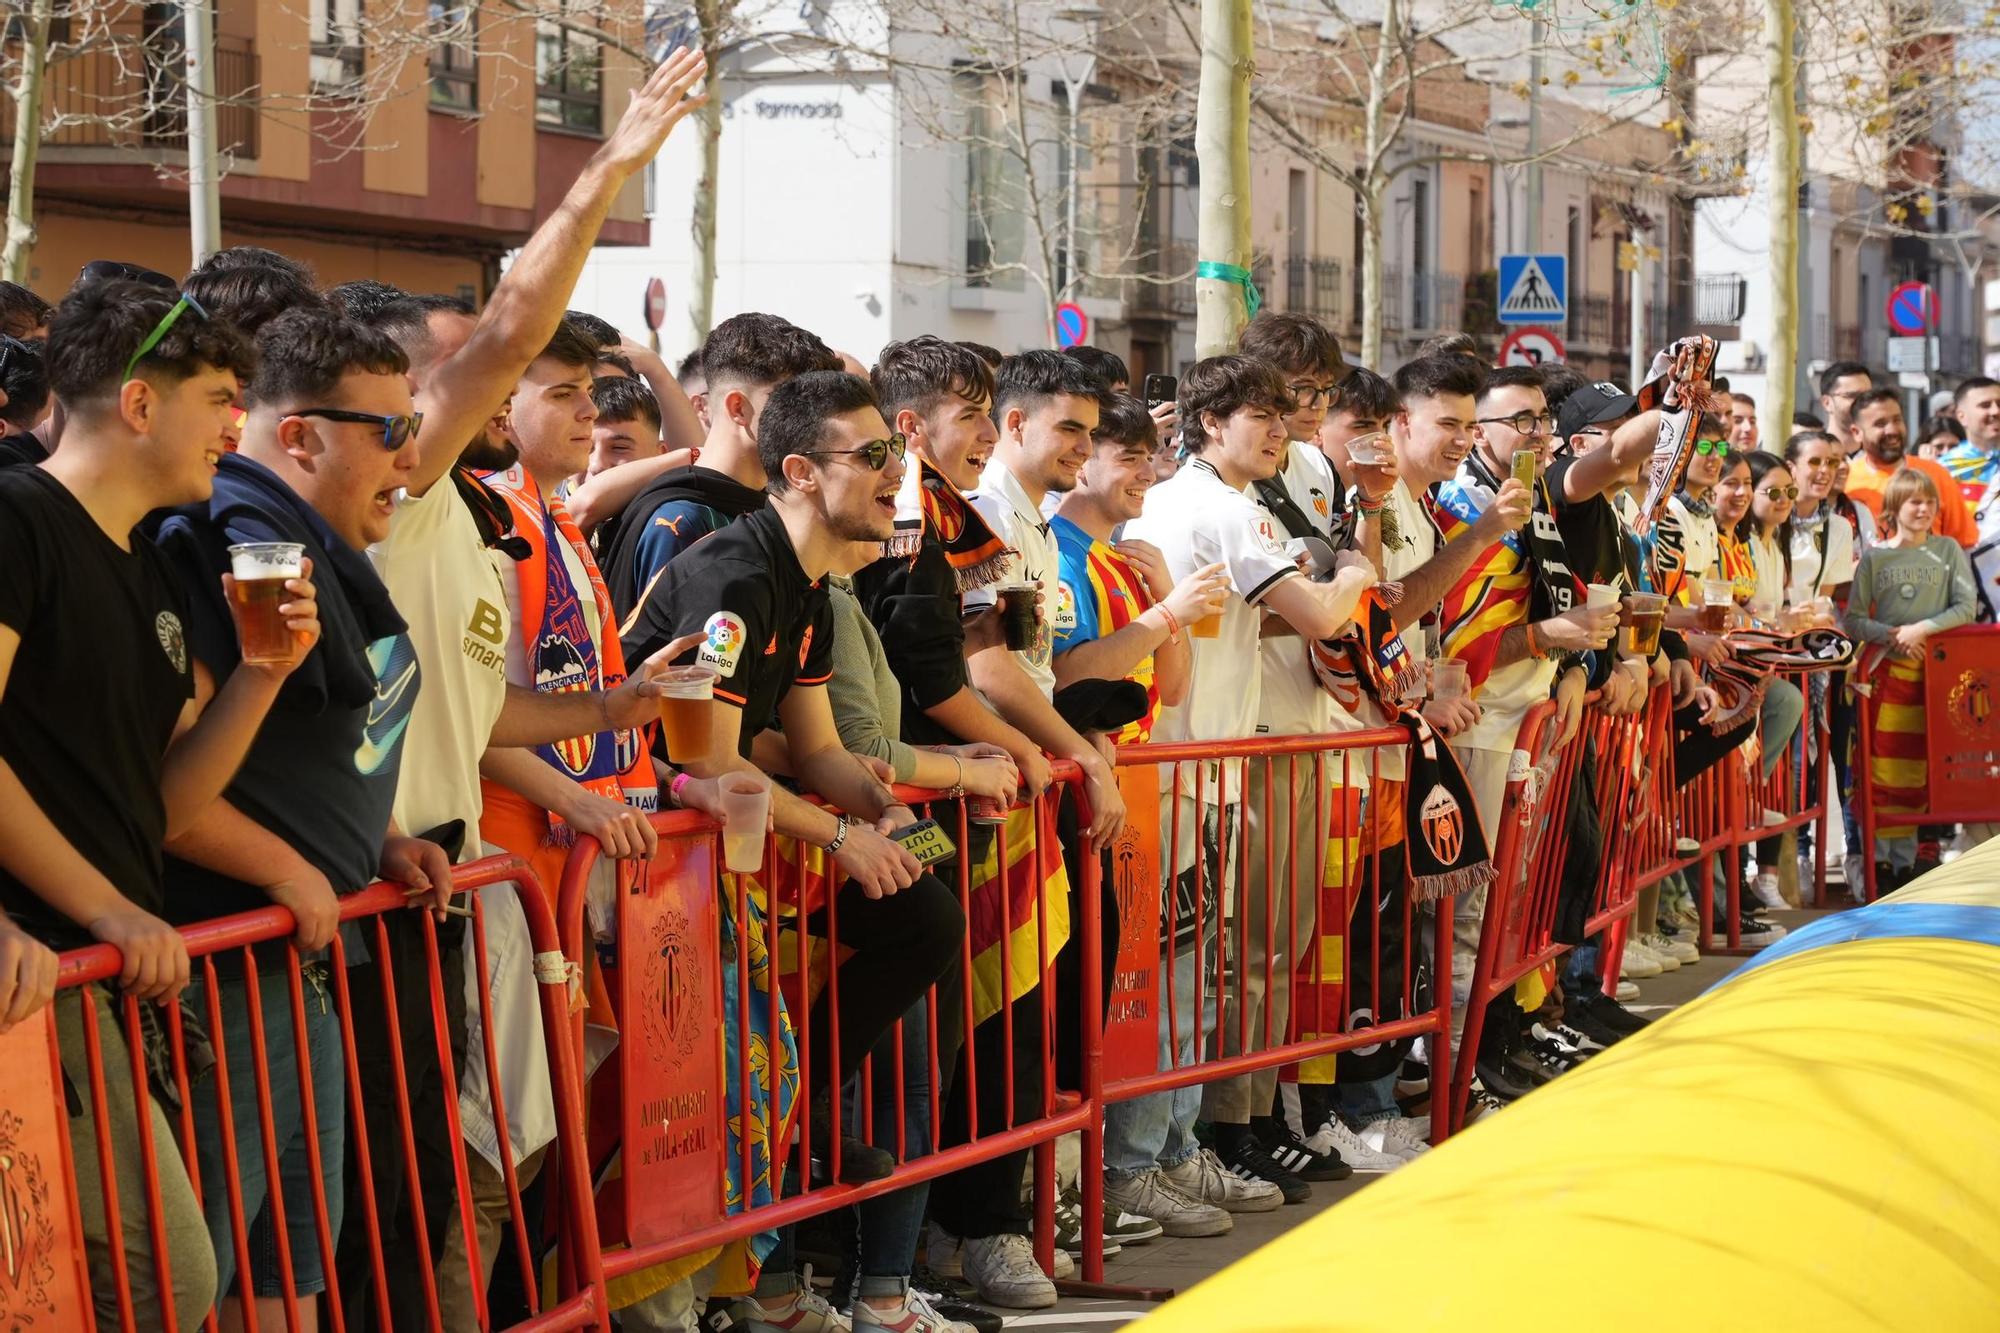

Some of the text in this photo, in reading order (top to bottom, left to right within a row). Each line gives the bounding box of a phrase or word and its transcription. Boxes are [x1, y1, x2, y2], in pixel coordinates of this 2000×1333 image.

[468, 598, 503, 644] B
[701, 652, 733, 668] LaLiga
[904, 830, 935, 851] OUT
[641, 1090, 707, 1128] AJUNTAMENT
[654, 1126, 706, 1161] VILA-REAL
